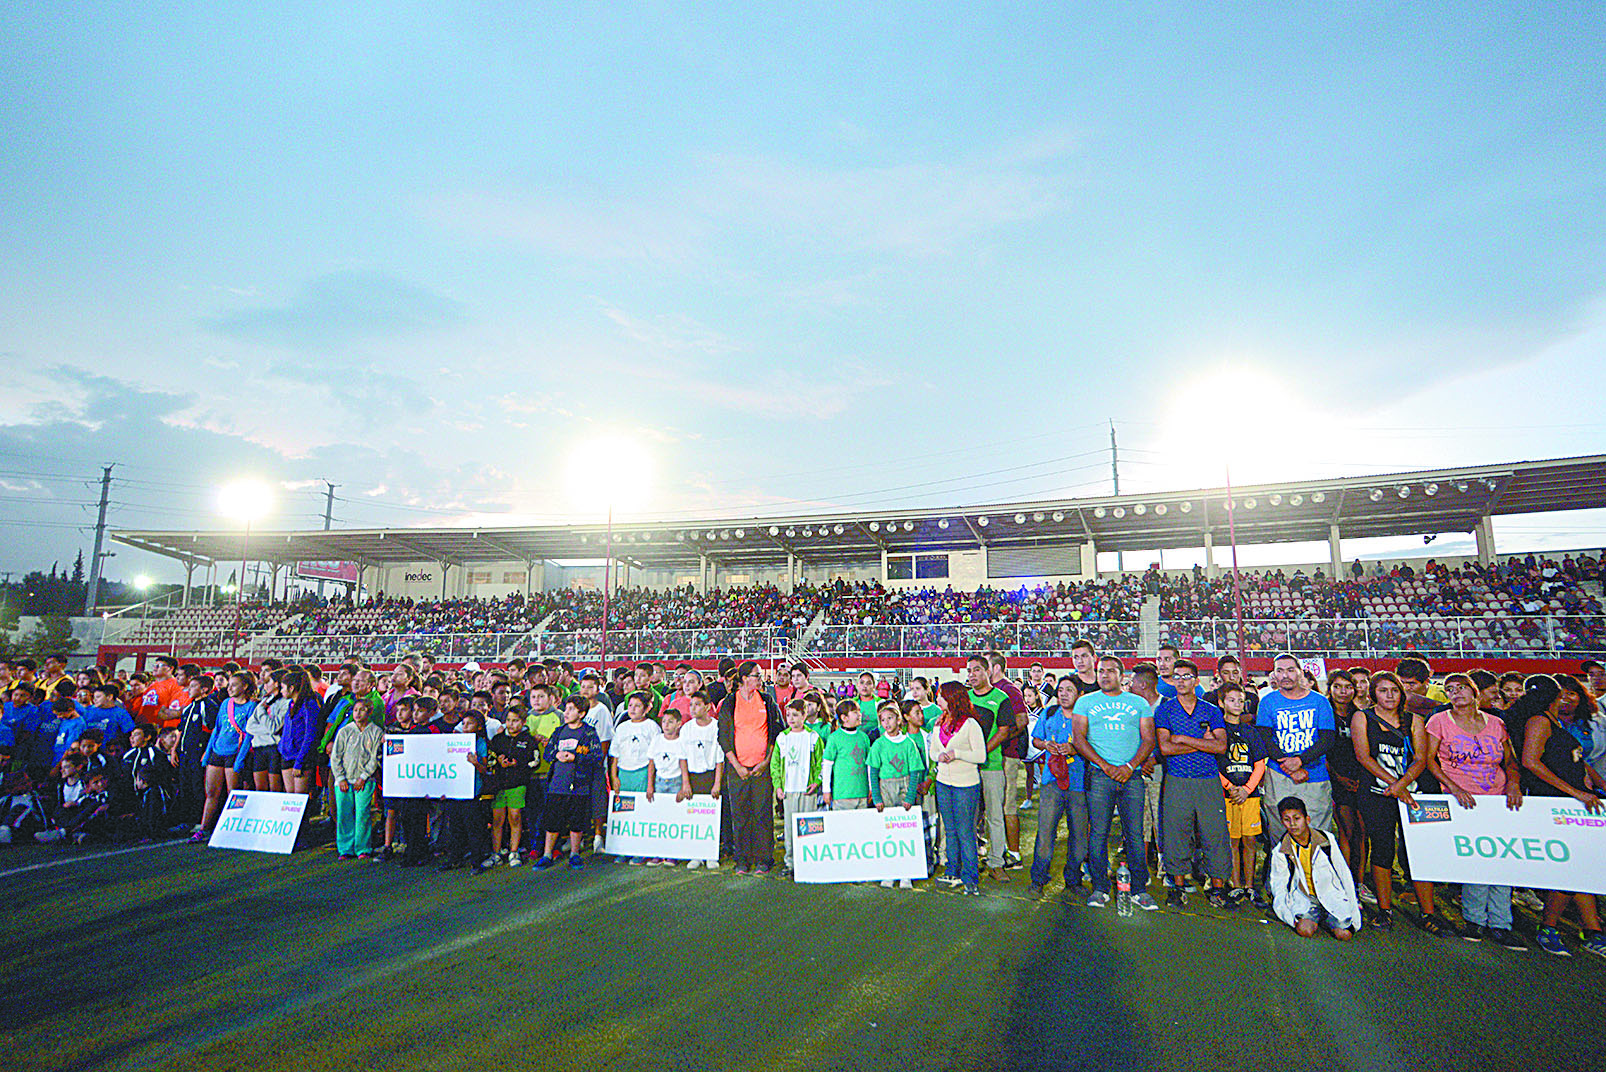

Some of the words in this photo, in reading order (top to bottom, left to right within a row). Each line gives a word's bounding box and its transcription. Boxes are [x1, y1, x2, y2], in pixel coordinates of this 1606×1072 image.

[405, 568, 432, 581] inedec
[1088, 702, 1138, 716] HOLLISTER
[1277, 708, 1316, 733] NEW
[1276, 727, 1316, 753] YORK
[397, 763, 457, 779] LUCHAS
[220, 816, 294, 836] ATLETISMO
[1425, 811, 1450, 820] 2016
[610, 819, 716, 841] HALTEROFILA
[802, 834, 916, 862] NATACIÓN
[1454, 834, 1571, 863] BOXEO
